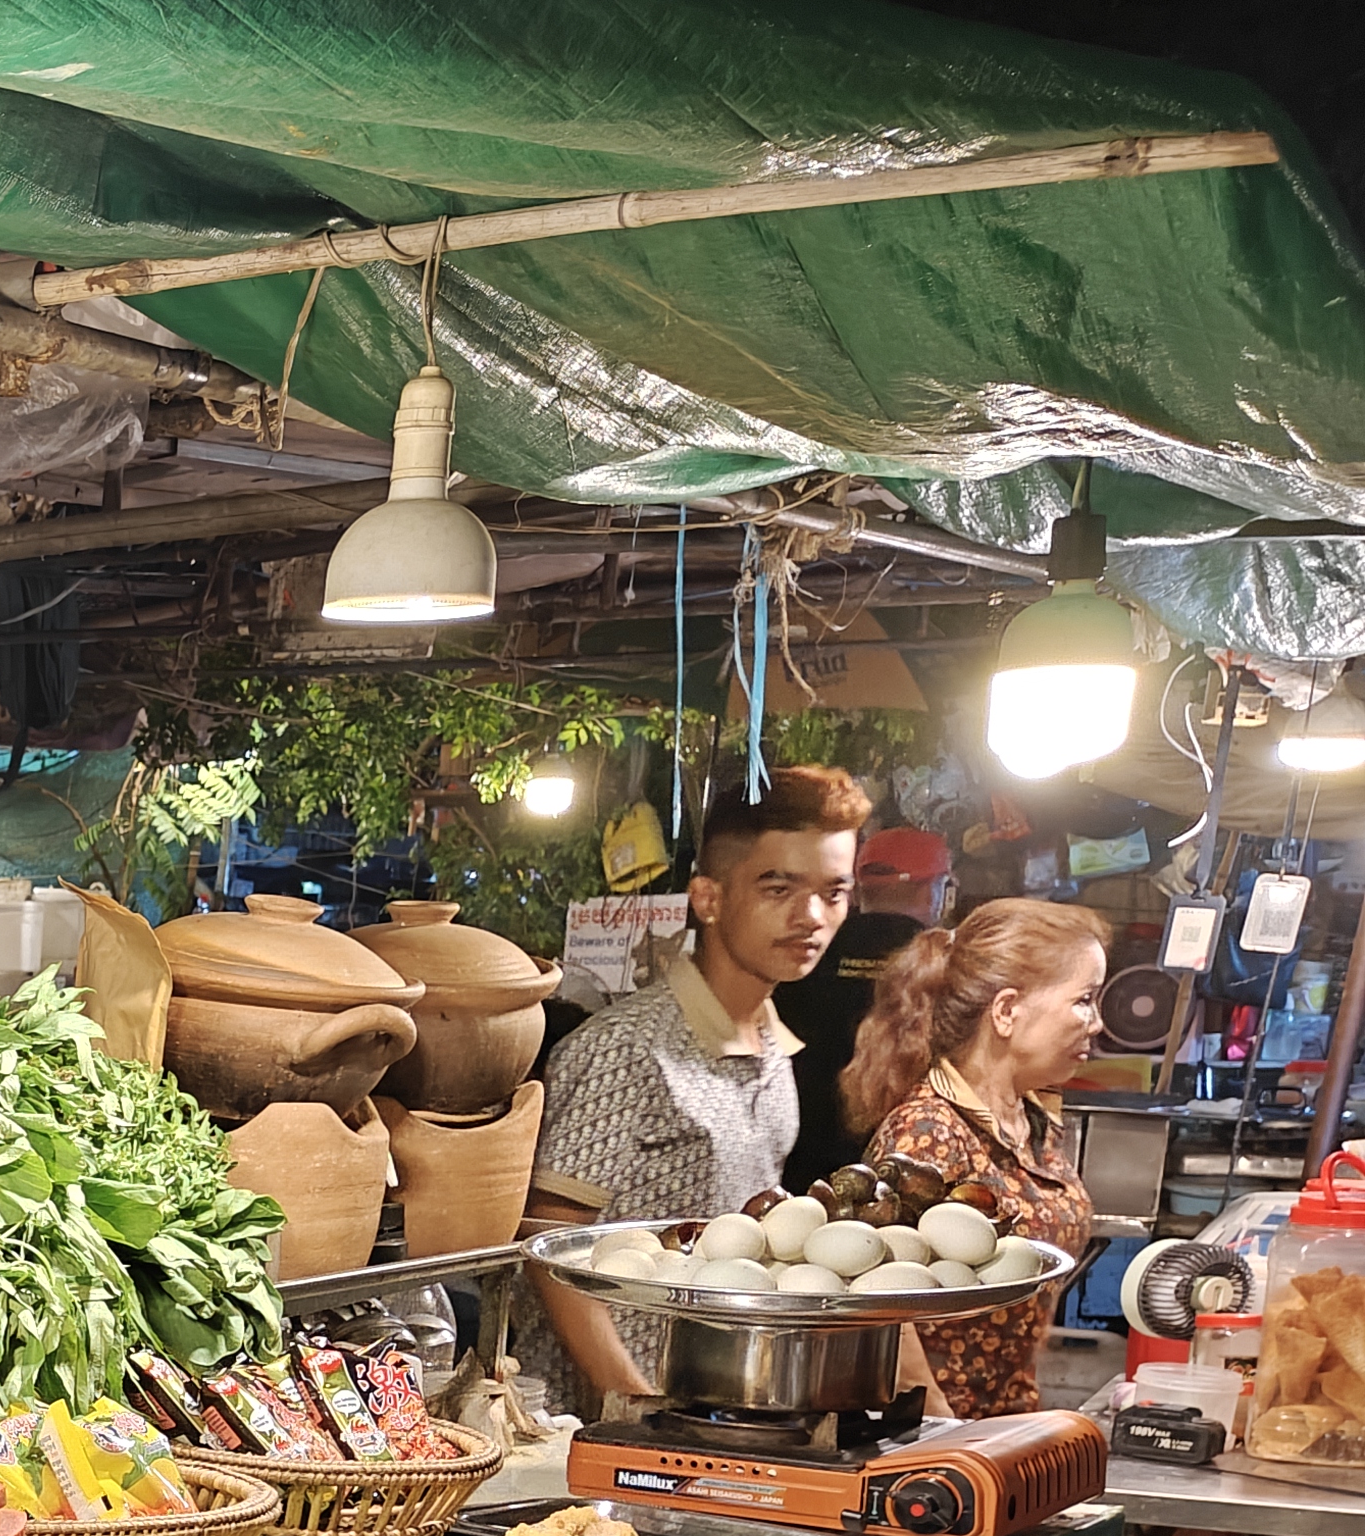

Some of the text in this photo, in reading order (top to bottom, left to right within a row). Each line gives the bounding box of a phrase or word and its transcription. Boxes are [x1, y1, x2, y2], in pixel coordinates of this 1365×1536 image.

[570, 935, 630, 947] Beware of
[617, 1471, 675, 1491] NaMilux
[687, 1487, 709, 1496] ASAHI
[759, 1496, 784, 1506] JAPAN
